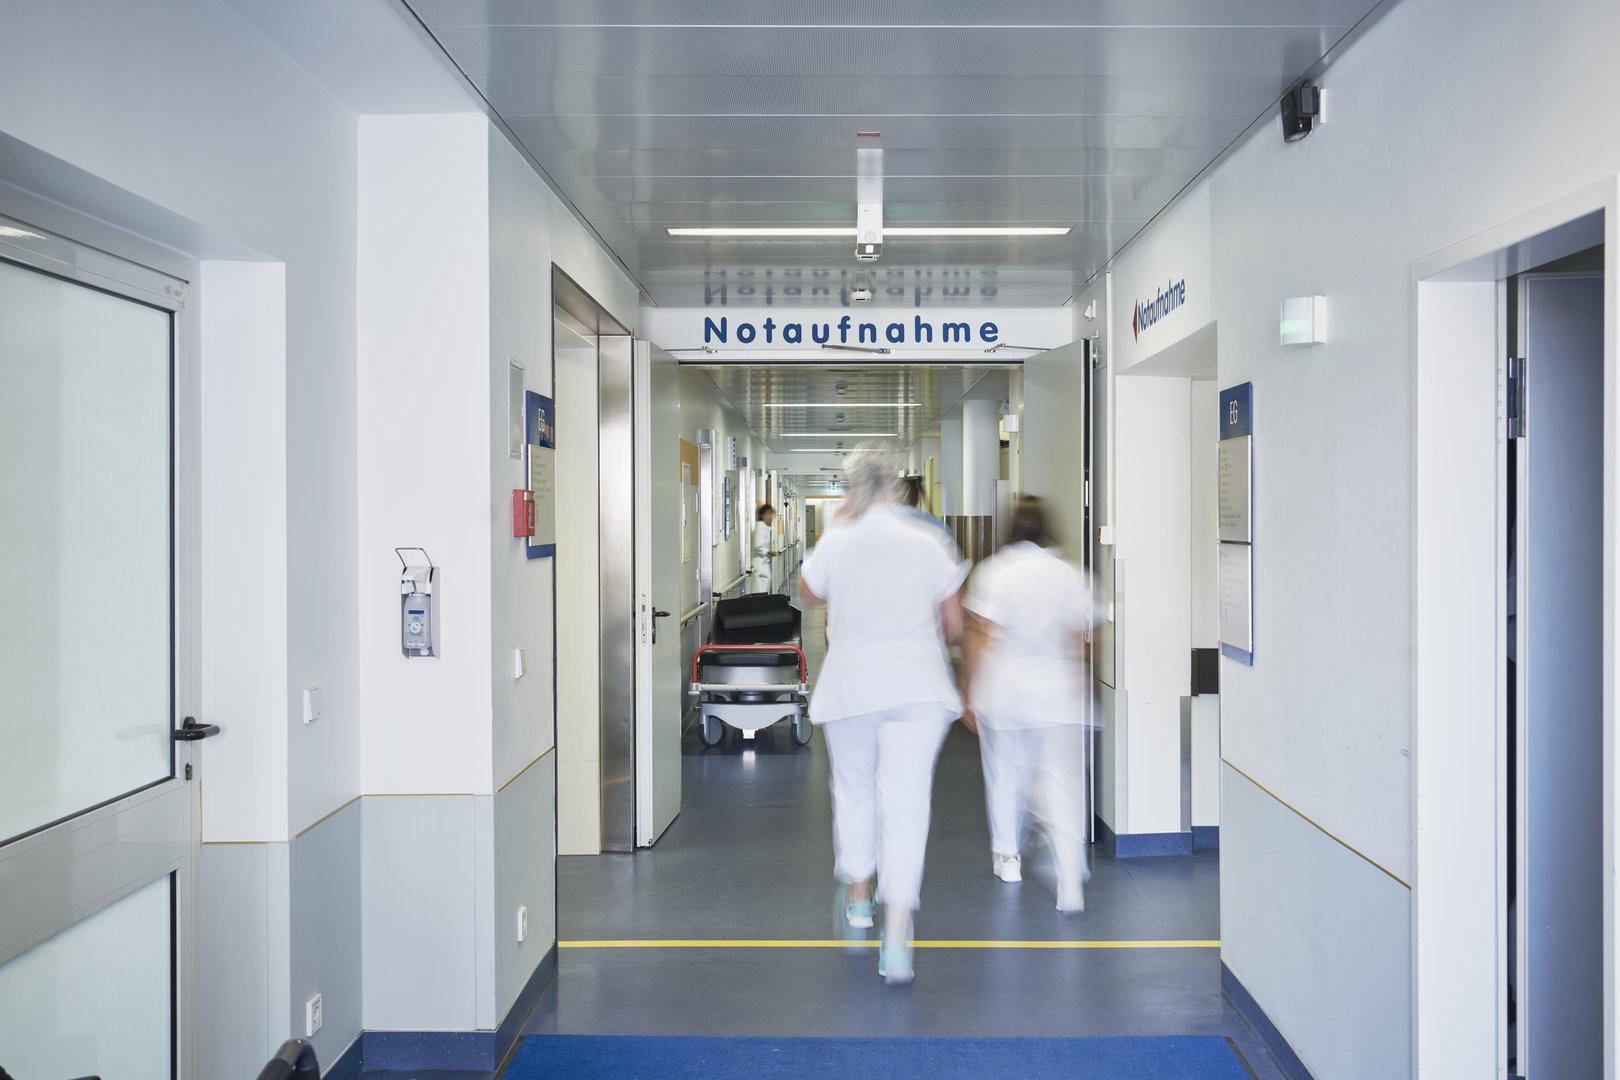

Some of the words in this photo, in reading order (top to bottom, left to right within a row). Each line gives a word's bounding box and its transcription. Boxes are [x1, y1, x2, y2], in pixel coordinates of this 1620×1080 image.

[1137, 278, 1185, 333] Notaufnahme
[703, 314, 999, 344] Notaufnahme
[1230, 400, 1238, 425] EG
